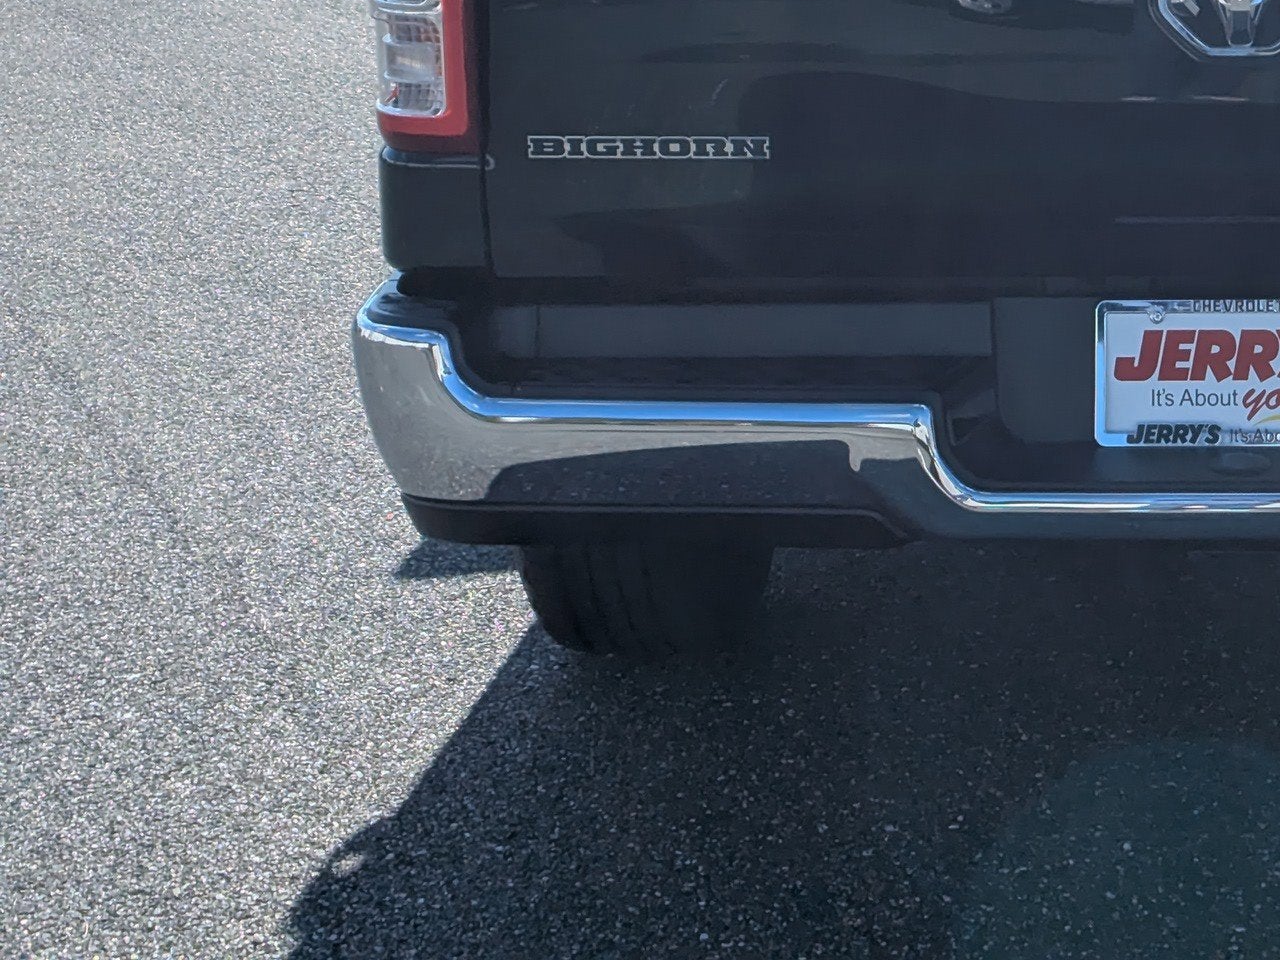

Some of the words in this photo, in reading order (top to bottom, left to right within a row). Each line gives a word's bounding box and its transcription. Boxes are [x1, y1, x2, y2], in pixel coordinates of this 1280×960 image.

[526, 135, 770, 159] BIGHORN
[1151, 388, 1175, 407] It's
[1179, 388, 1239, 407] About
[1126, 423, 1222, 445] JERRY'S
[1229, 427, 1250, 443] It's
